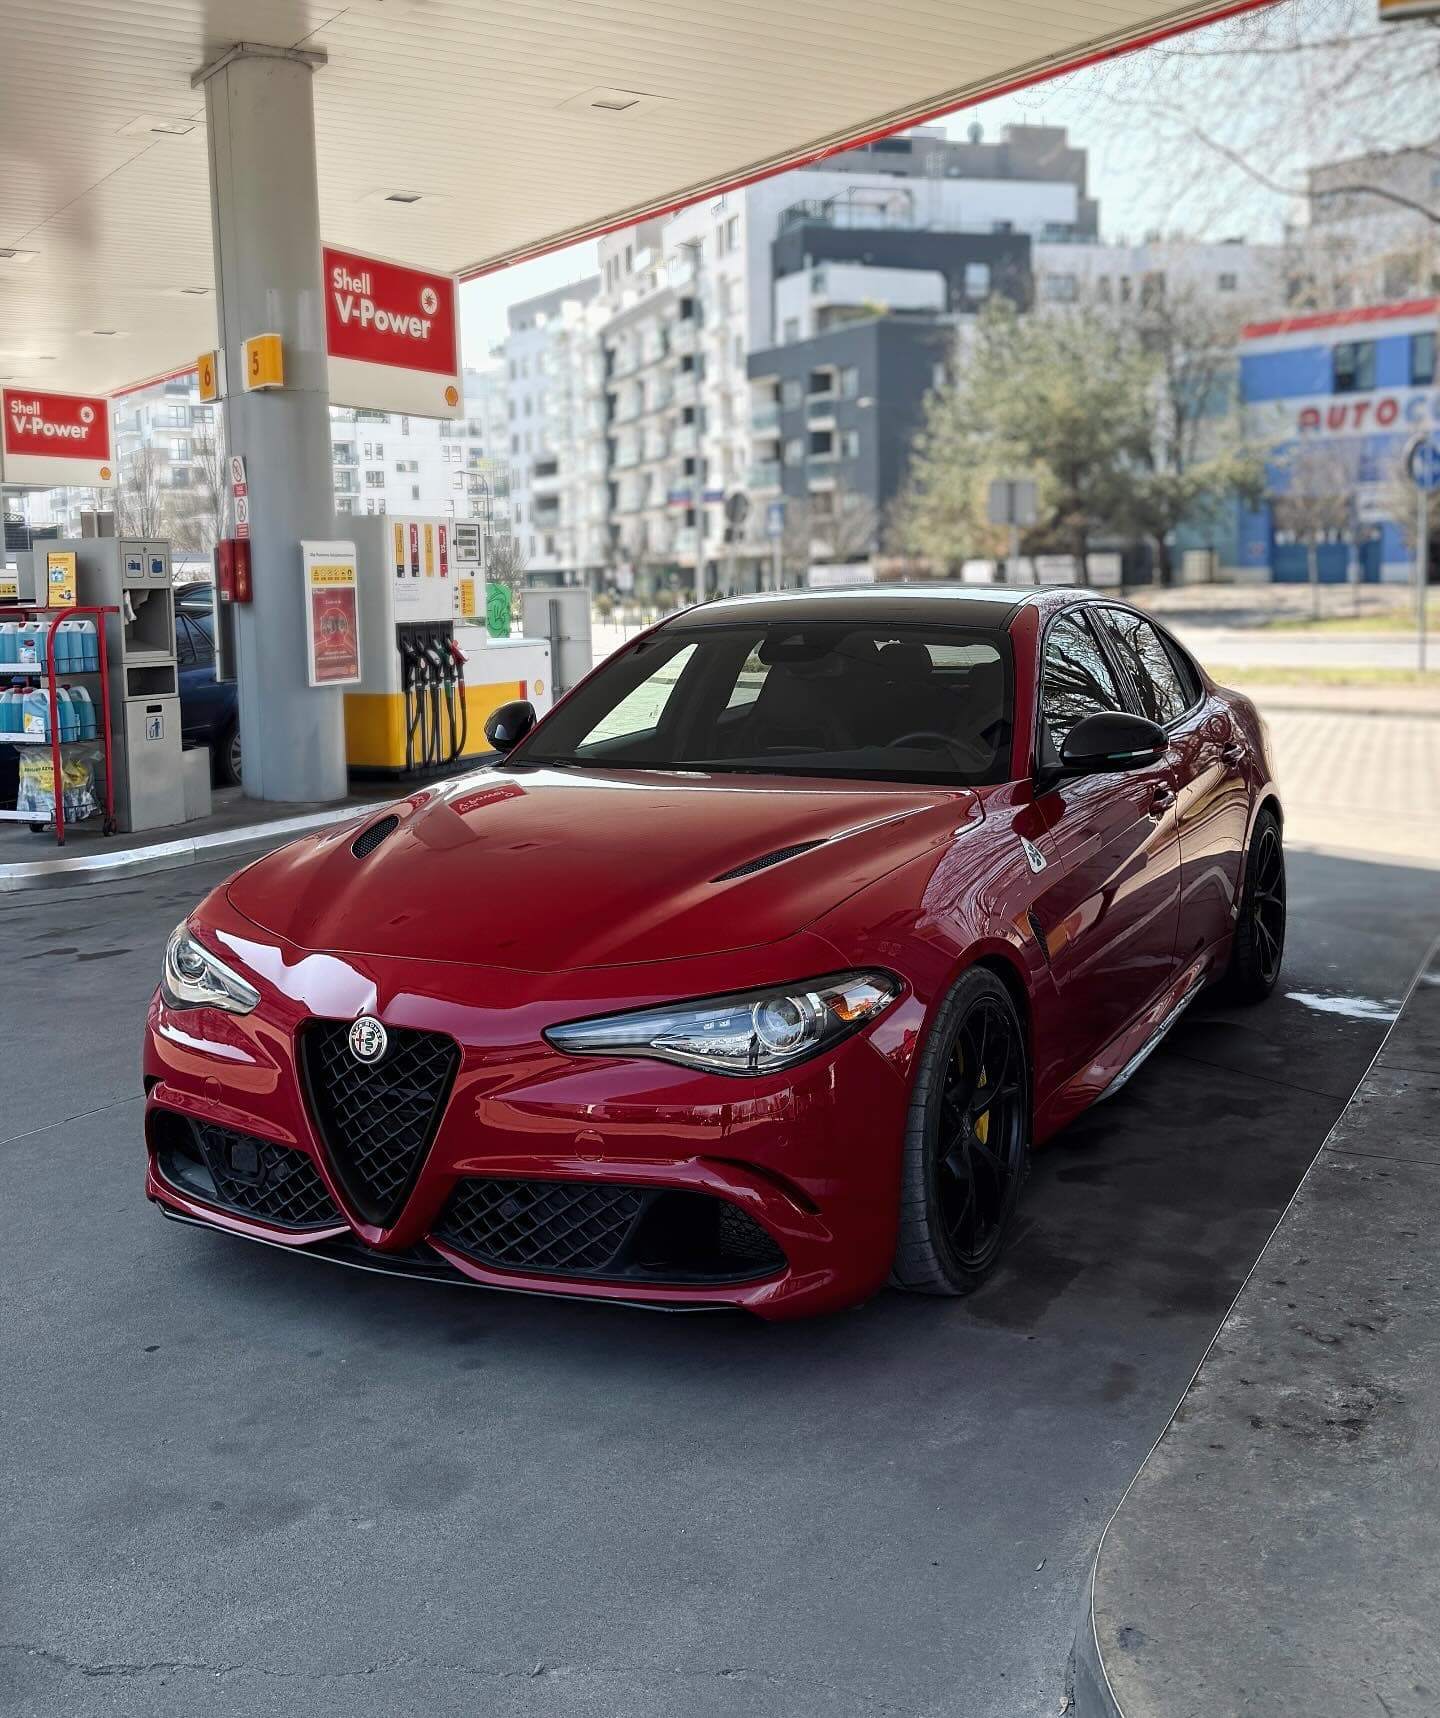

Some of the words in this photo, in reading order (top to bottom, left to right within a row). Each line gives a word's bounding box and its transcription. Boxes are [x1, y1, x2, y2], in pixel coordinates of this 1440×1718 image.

[333, 267, 371, 295] Shell
[334, 293, 432, 339] V-Power
[204, 364, 211, 387] 6
[252, 350, 260, 376] 5
[11, 400, 40, 415] Shell
[12, 415, 89, 439] V-Power
